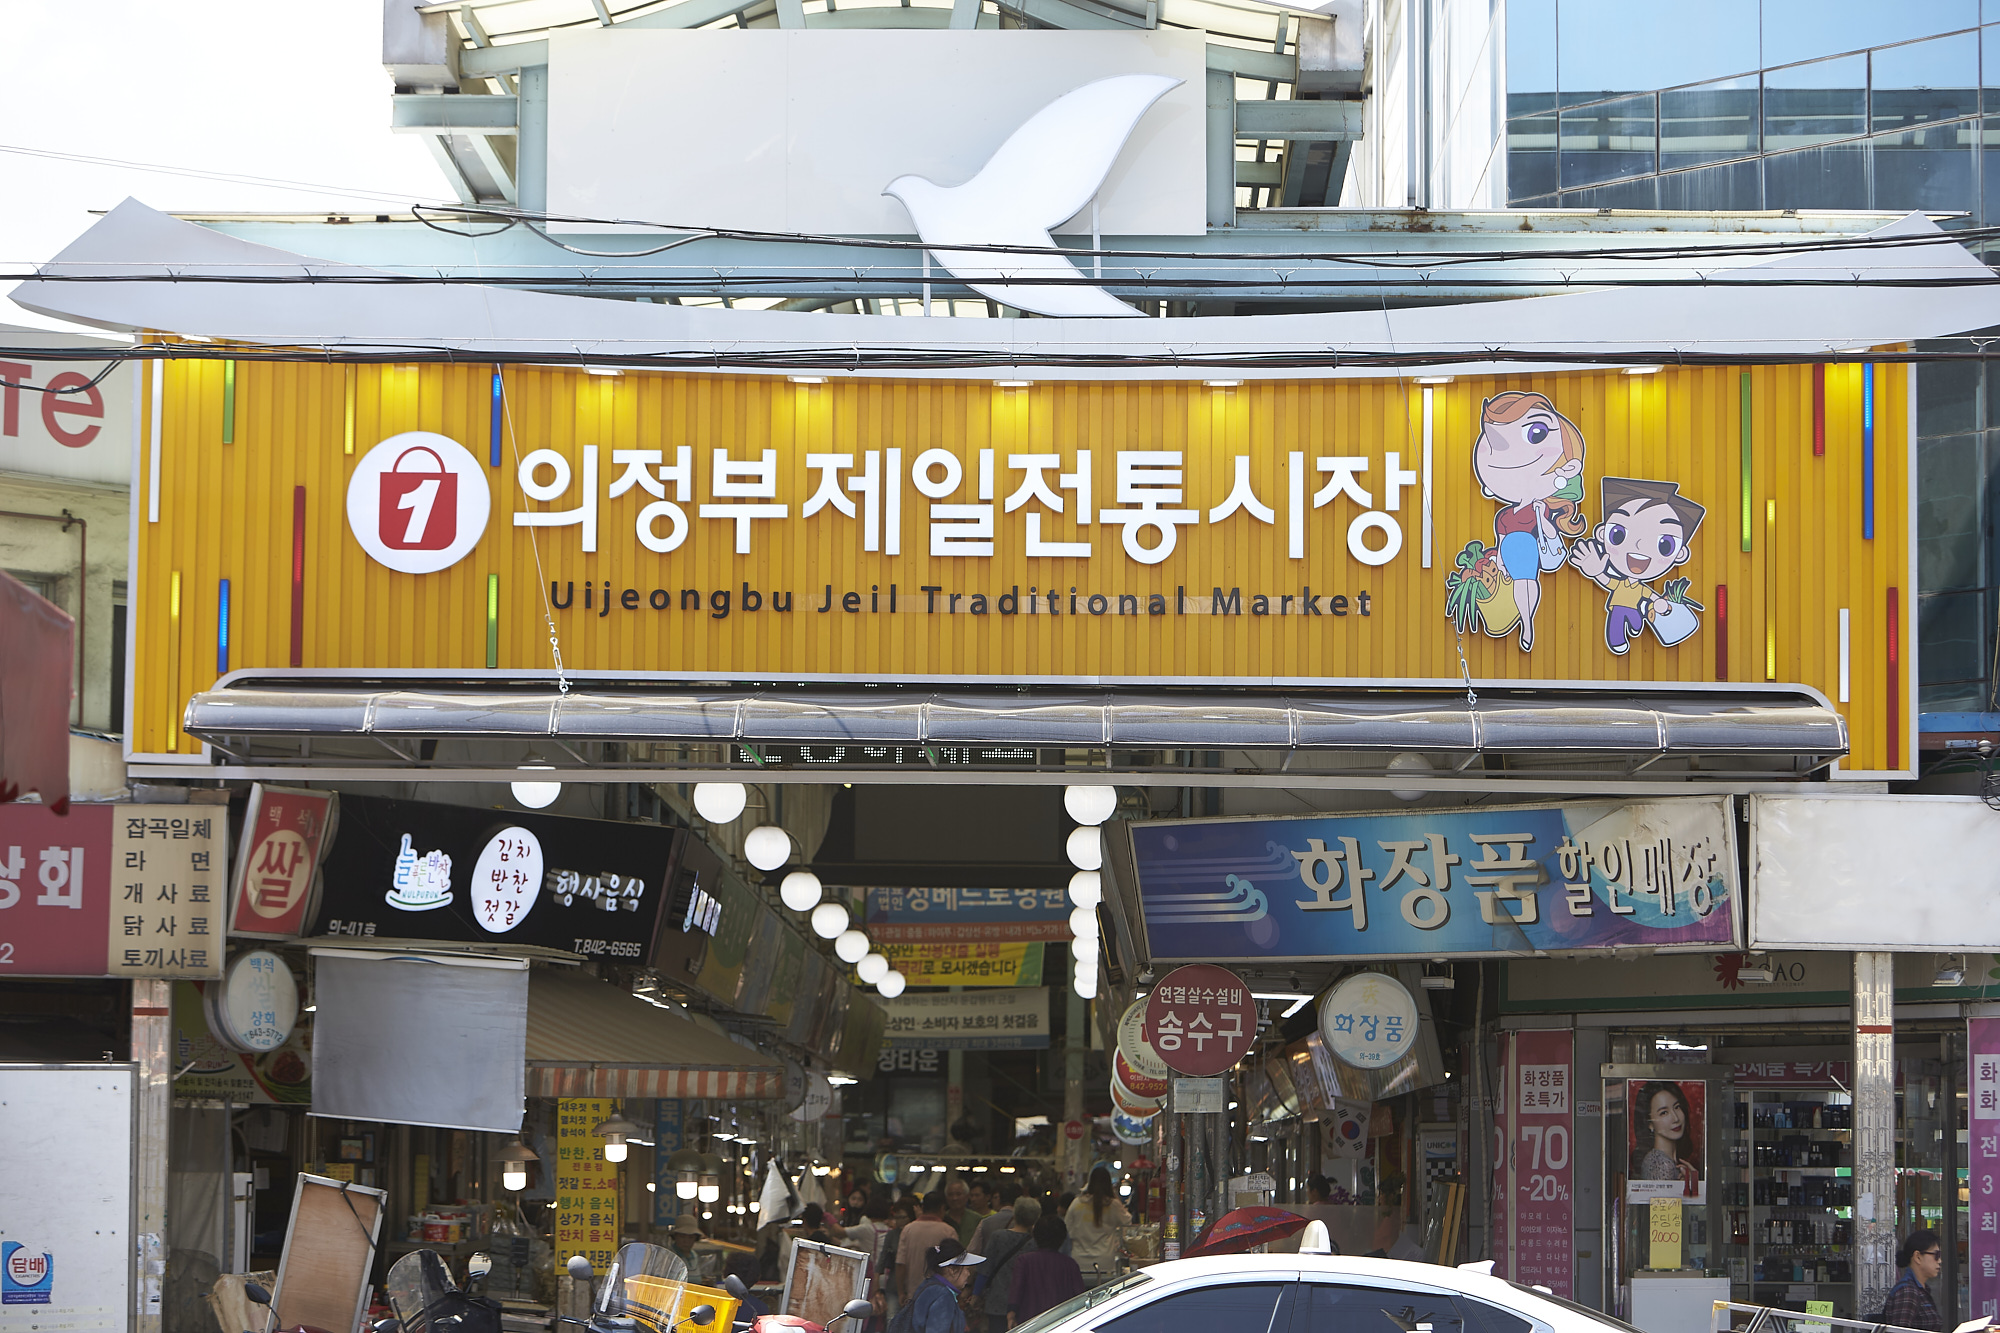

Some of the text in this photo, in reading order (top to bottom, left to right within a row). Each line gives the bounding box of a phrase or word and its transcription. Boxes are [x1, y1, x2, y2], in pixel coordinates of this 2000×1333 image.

[513, 444, 1417, 566] 의정부제일전통시장
[550, 581, 1371, 619] Uijeongbu Jeil Traditional Market
[126, 818, 212, 840] 잡곡일체
[498, 838, 531, 862] 김치
[257, 840, 304, 908] 쌀
[491, 869, 528, 894] 반찬
[1292, 833, 1717, 931] 화장품 할인매장
[554, 870, 645, 912] 행사음식
[484, 899, 520, 925] 젓갈
[327, 919, 377, 938] 의-41호
[573, 938, 641, 958] T.842-6565
[122, 948, 209, 969] 토끼사료
[250, 958, 274, 973] 백석
[1159, 986, 1242, 1006] 연결살수설비
[250, 1011, 276, 1027] 상회
[962, 1014, 998, 1029] 보호의
[1002, 1013, 1039, 1029] 첫걸음
[1334, 1013, 1404, 1043] 화장품
[1157, 1011, 1243, 1053] 송수구
[1523, 1070, 1565, 1087] 화장품
[1523, 1090, 1565, 1108] 초특가
[1521, 1125, 1569, 1170] 70
[559, 1177, 579, 1190] 젓갈
[1520, 1174, 1569, 1201] ~20%
[559, 1196, 615, 1210] 행사 음식
[559, 1213, 615, 1227] 상가 음식
[559, 1229, 614, 1243] 잔치 음식
[1651, 1229, 1680, 1243] 2000
[12, 1257, 45, 1274] 담배
